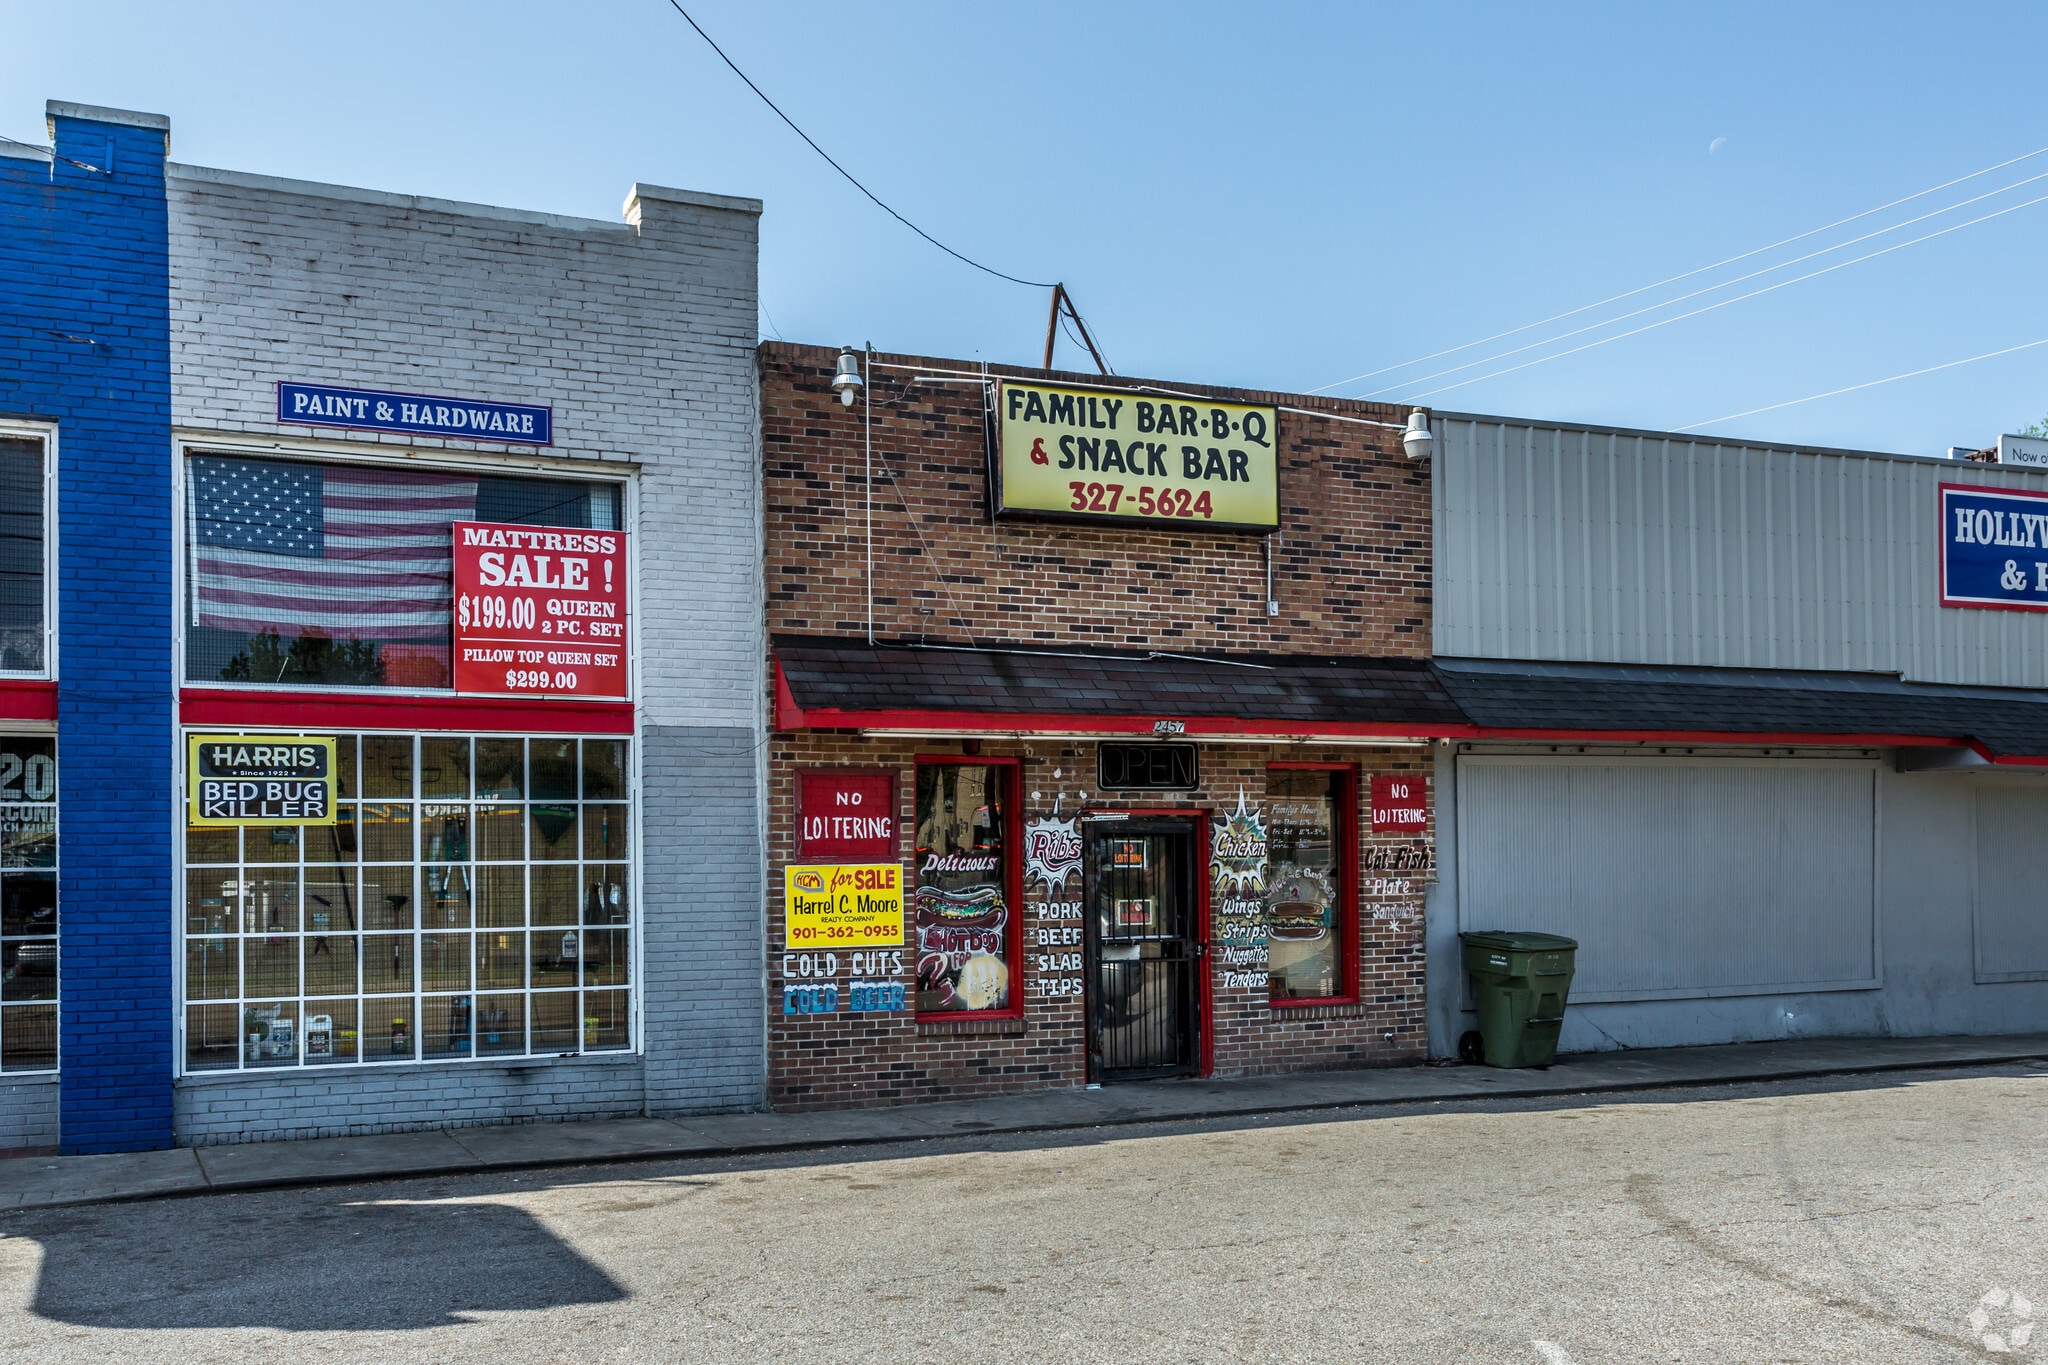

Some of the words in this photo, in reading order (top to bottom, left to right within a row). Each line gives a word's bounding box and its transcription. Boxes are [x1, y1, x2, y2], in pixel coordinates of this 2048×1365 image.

[294, 392, 368, 418] PAINT
[375, 401, 394, 421] &
[401, 403, 534, 434] HARDWARE
[1007, 389, 1122, 430] FAMILY
[1030, 437, 1048, 466] &
[1058, 434, 1167, 476] SNACK
[1181, 445, 1250, 482] BAR
[2012, 448, 2038, 462] Now
[1069, 481, 1213, 518] 327-5624
[462, 528, 617, 554] MATTRESS
[479, 552, 589, 591] SALE
[2000, 559, 2027, 591] &
[458, 592, 536, 632] $199.00
[546, 599, 616, 618] QUEEN
[541, 620, 552, 634] 2
[557, 620, 584, 636] PC.
[590, 622, 623, 637] SET
[463, 648, 514, 663] PILLOW
[517, 650, 544, 664] TOP
[547, 651, 591, 666] QUEEN
[594, 654, 618, 666] SET
[505, 669, 577, 690] $299.00
[1153, 721, 1184, 732] 2457
[0, 753, 54, 800] 20
[1104, 747, 1192, 785] OPEN
[204, 782, 258, 801] BED
[267, 782, 323, 801] BUG
[836, 792, 862, 806] NO
[1391, 784, 1409, 798] NO
[204, 801, 324, 817] KILLER
[1373, 809, 1426, 823] LOITERING
[804, 816, 891, 840] LOITERING
[1030, 831, 1082, 869] Ribs
[1123, 844, 1134, 853] NO
[1215, 833, 1266, 857] Chicken
[920, 854, 998, 876] Delicious
[1114, 854, 1143, 863] LOITRING
[1365, 845, 1391, 870] Cat
[1394, 845, 1432, 870] Fish
[830, 867, 853, 893] for
[1373, 878, 1410, 895] Plate
[794, 895, 834, 915] Harrel
[839, 894, 852, 913] C.
[857, 894, 898, 913] Moore
[1038, 902, 1082, 919] PORK
[1222, 896, 1261, 918] Wings
[792, 925, 898, 939] 901-362-0955
[1038, 929, 1082, 945] BEEF
[1223, 923, 1267, 943] Strips
[782, 952, 837, 977] COLD
[852, 951, 903, 975] CUTS
[1038, 953, 1082, 971] SLAB
[1038, 978, 1082, 996] TIPS
[1223, 970, 1268, 987] Tenders
[783, 983, 838, 1015] COLD
[849, 980, 906, 1012] BEER
